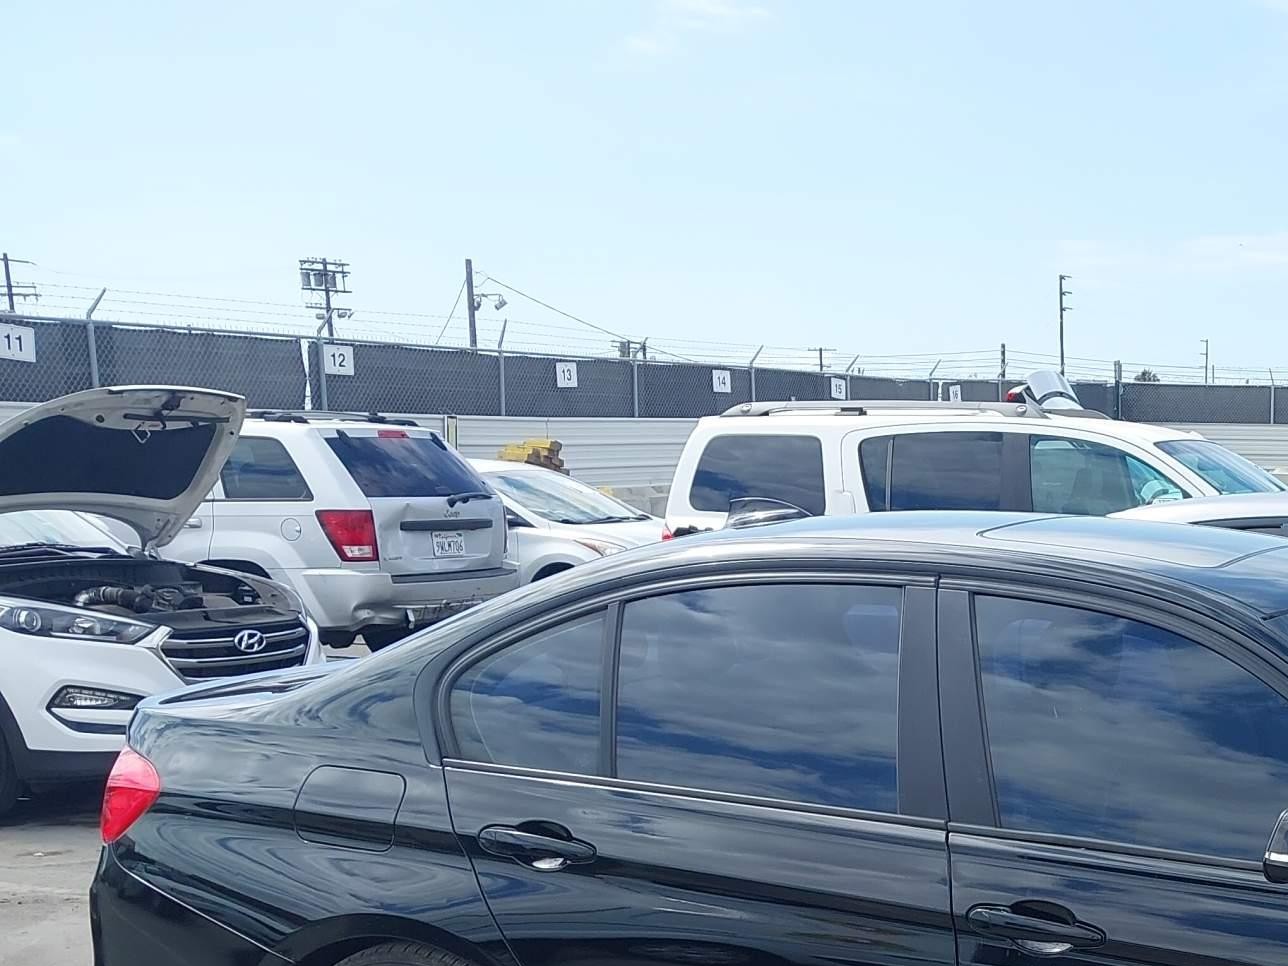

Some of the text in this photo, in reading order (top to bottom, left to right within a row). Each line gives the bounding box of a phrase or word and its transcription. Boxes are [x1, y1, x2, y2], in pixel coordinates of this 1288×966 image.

[3, 333, 23, 352] 11
[330, 352, 347, 367] 12
[562, 368, 572, 381] 13
[717, 376, 726, 387] 14
[835, 384, 843, 394] 15
[952, 390, 959, 399] 16
